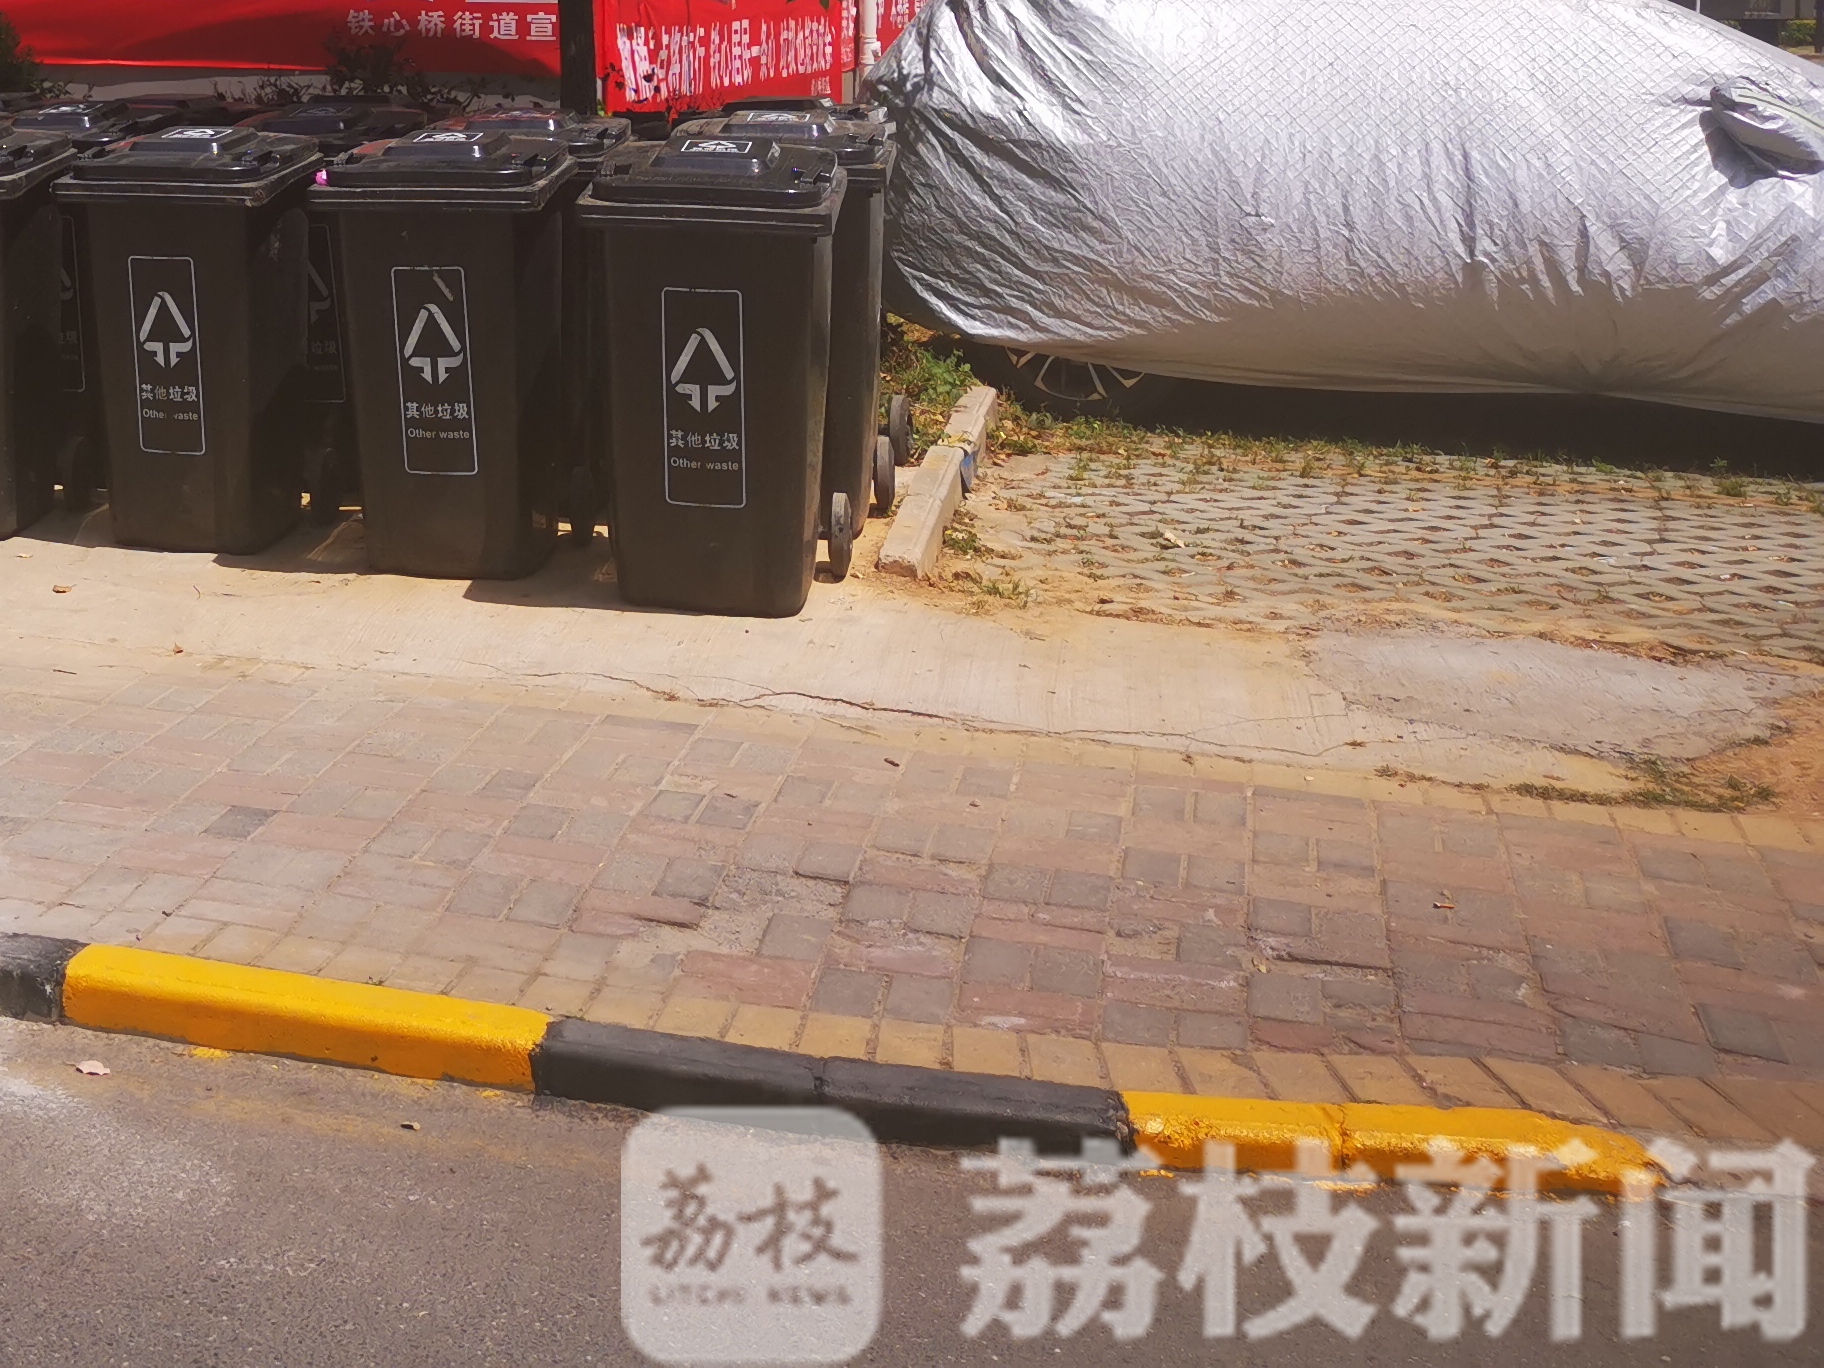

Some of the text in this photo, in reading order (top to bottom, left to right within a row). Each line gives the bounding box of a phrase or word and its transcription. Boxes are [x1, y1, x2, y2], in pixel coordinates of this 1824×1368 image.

[346, 9, 558, 41] 铁心桥街道宣
[141, 383, 198, 402] 其他垃圾
[405, 401, 470, 420] 其他垃圾
[407, 428, 470, 439] Other waste
[669, 429, 740, 450] 其他垃圾
[670, 456, 740, 471] Other waste
